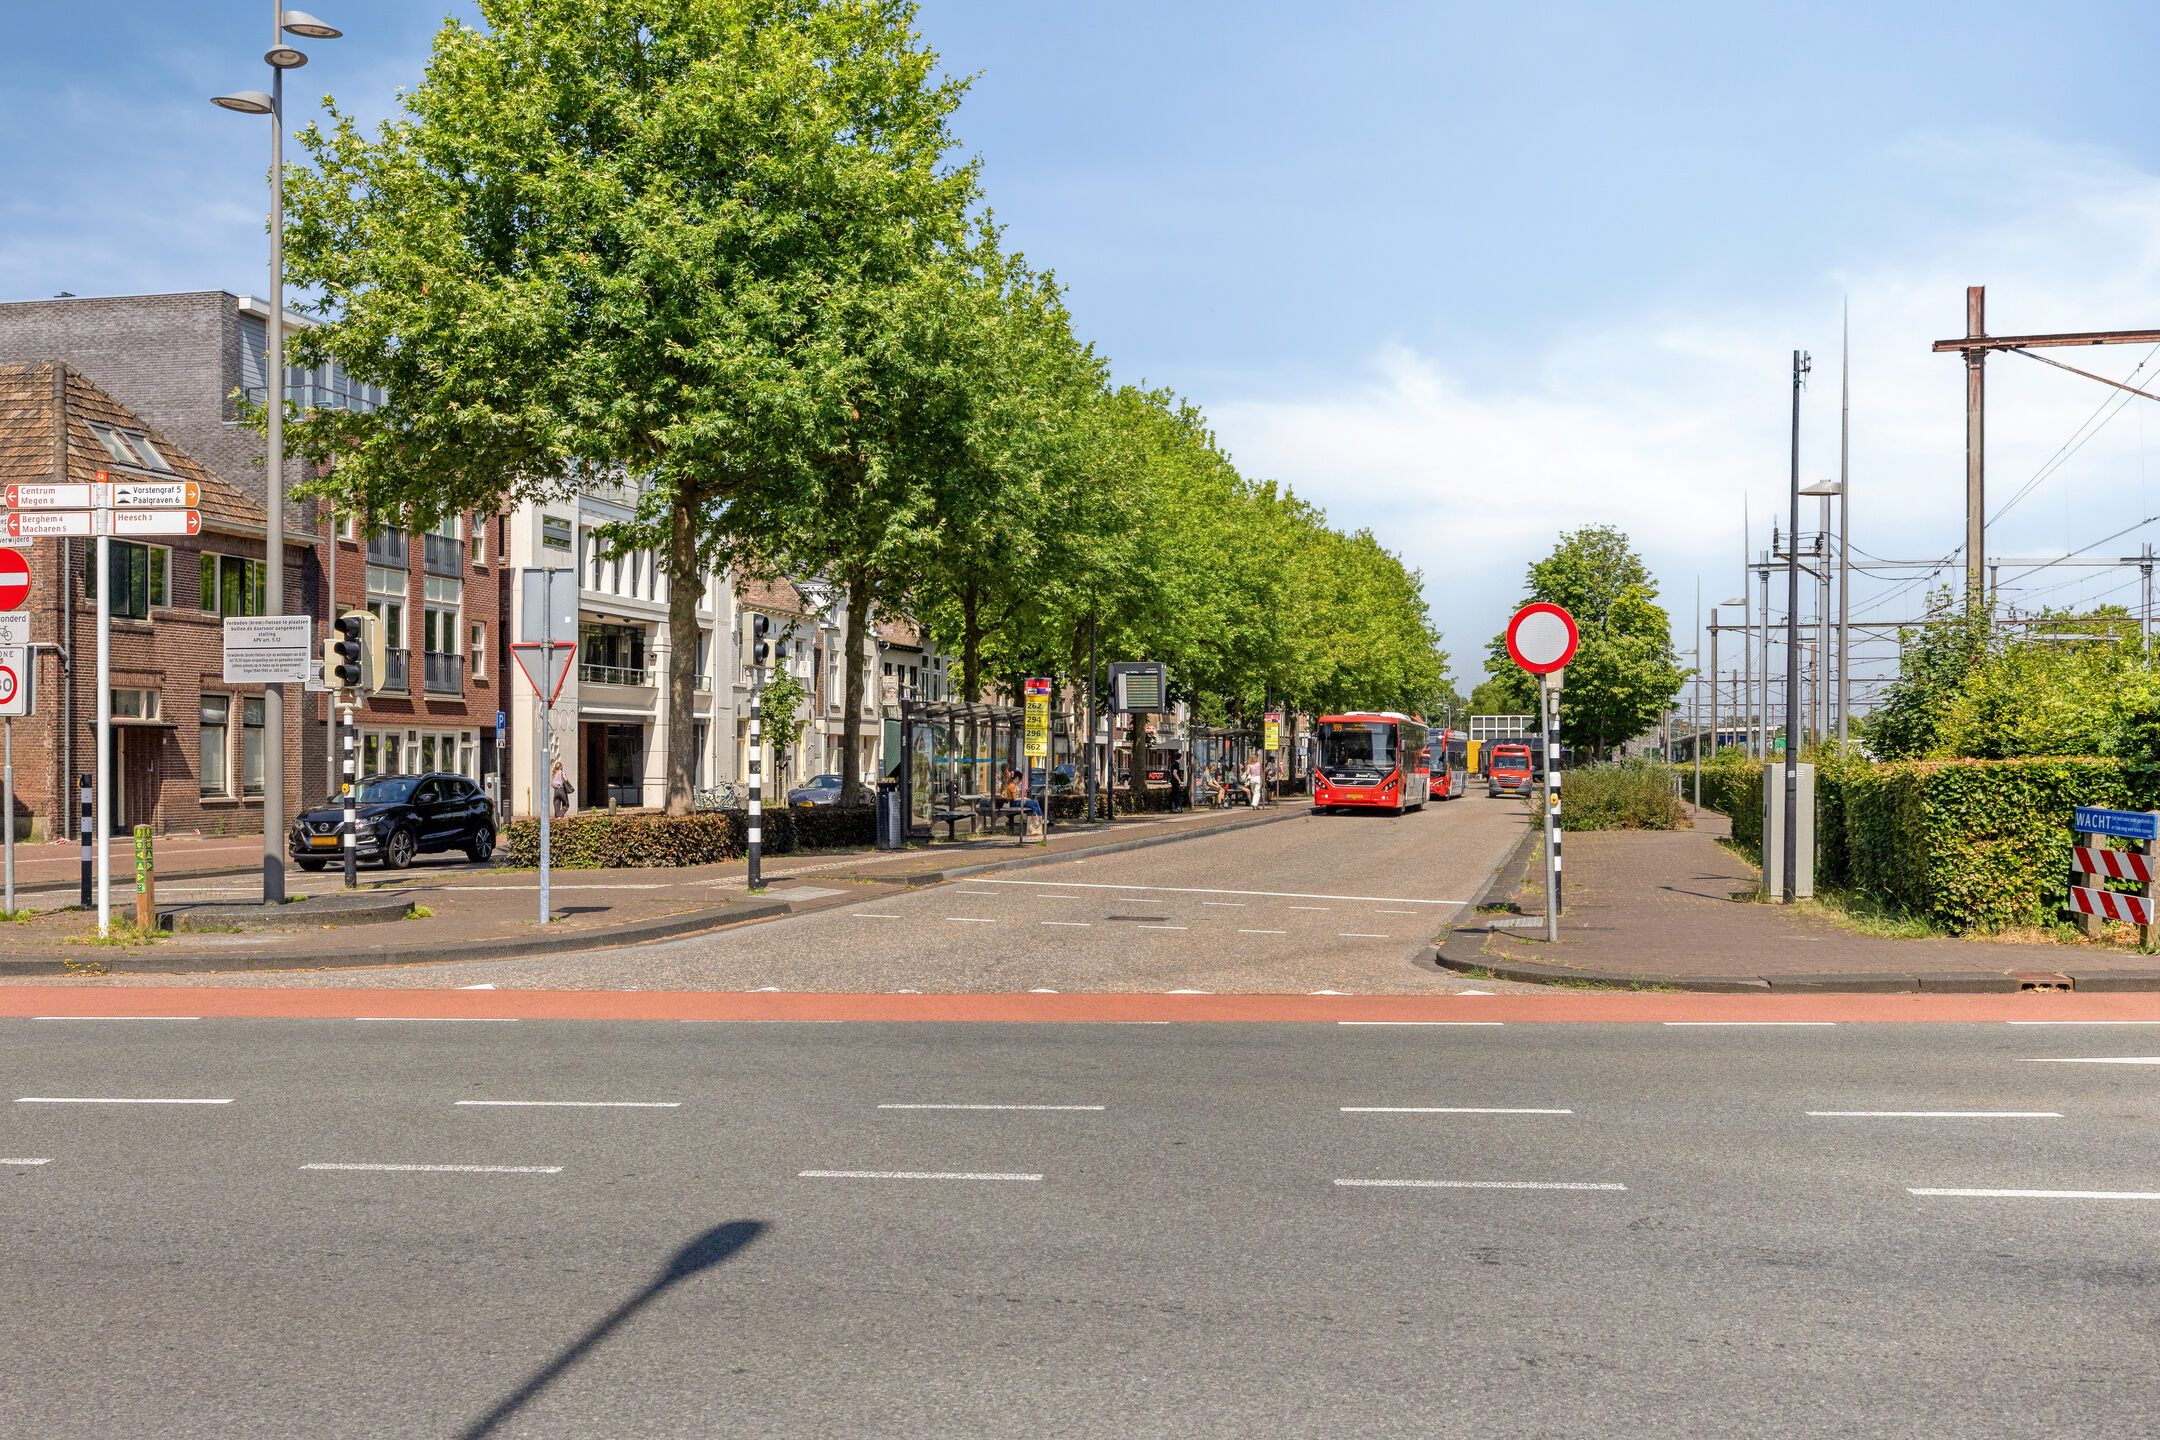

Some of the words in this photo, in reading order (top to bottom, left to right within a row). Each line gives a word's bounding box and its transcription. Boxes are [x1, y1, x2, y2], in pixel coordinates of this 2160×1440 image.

[133, 486, 175, 495] Vorstengraf
[132, 497, 173, 505] Paalgraven
[22, 516, 57, 524] Berghem
[499, 714, 504, 728] P
[1026, 743, 1041, 751] 662
[2076, 813, 2111, 829] WACHT
